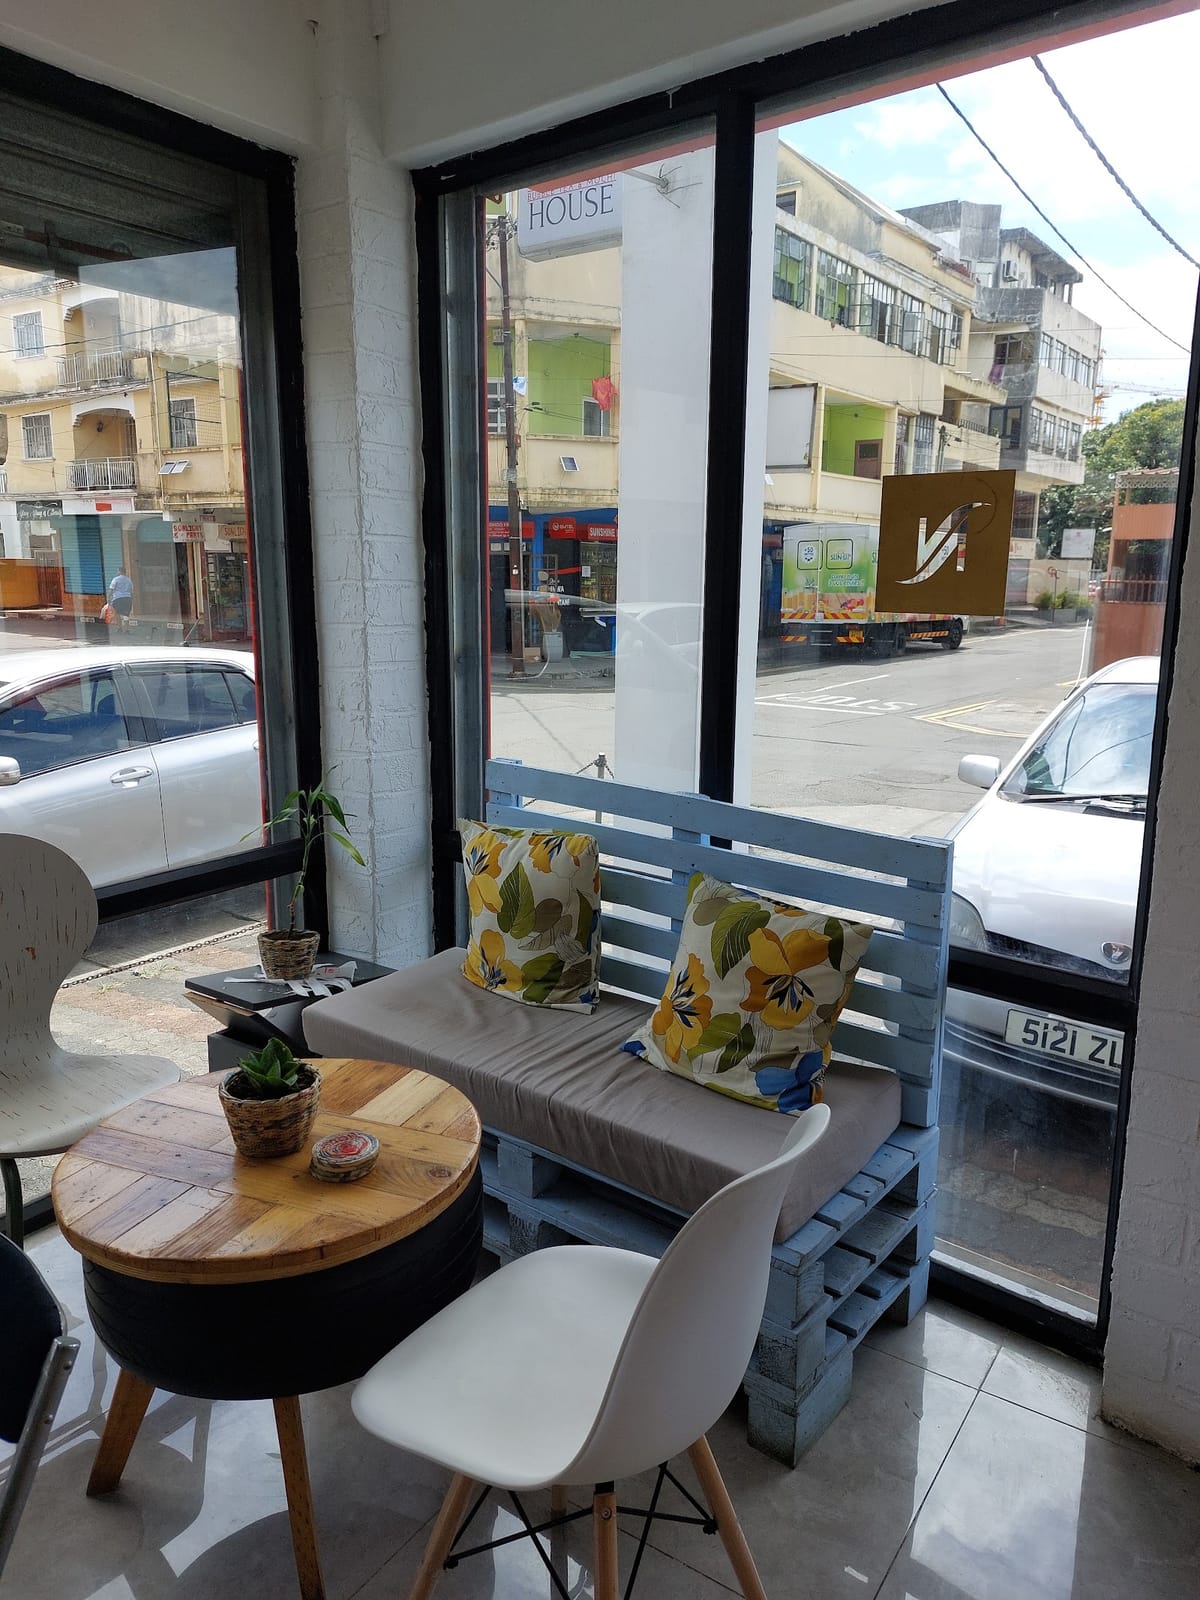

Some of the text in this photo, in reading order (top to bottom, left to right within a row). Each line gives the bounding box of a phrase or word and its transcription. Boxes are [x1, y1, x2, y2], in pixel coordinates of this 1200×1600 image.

[529, 184, 614, 230] HOUSE
[589, 527, 616, 537] SUNSHINE
[775, 694, 919, 712] STOP
